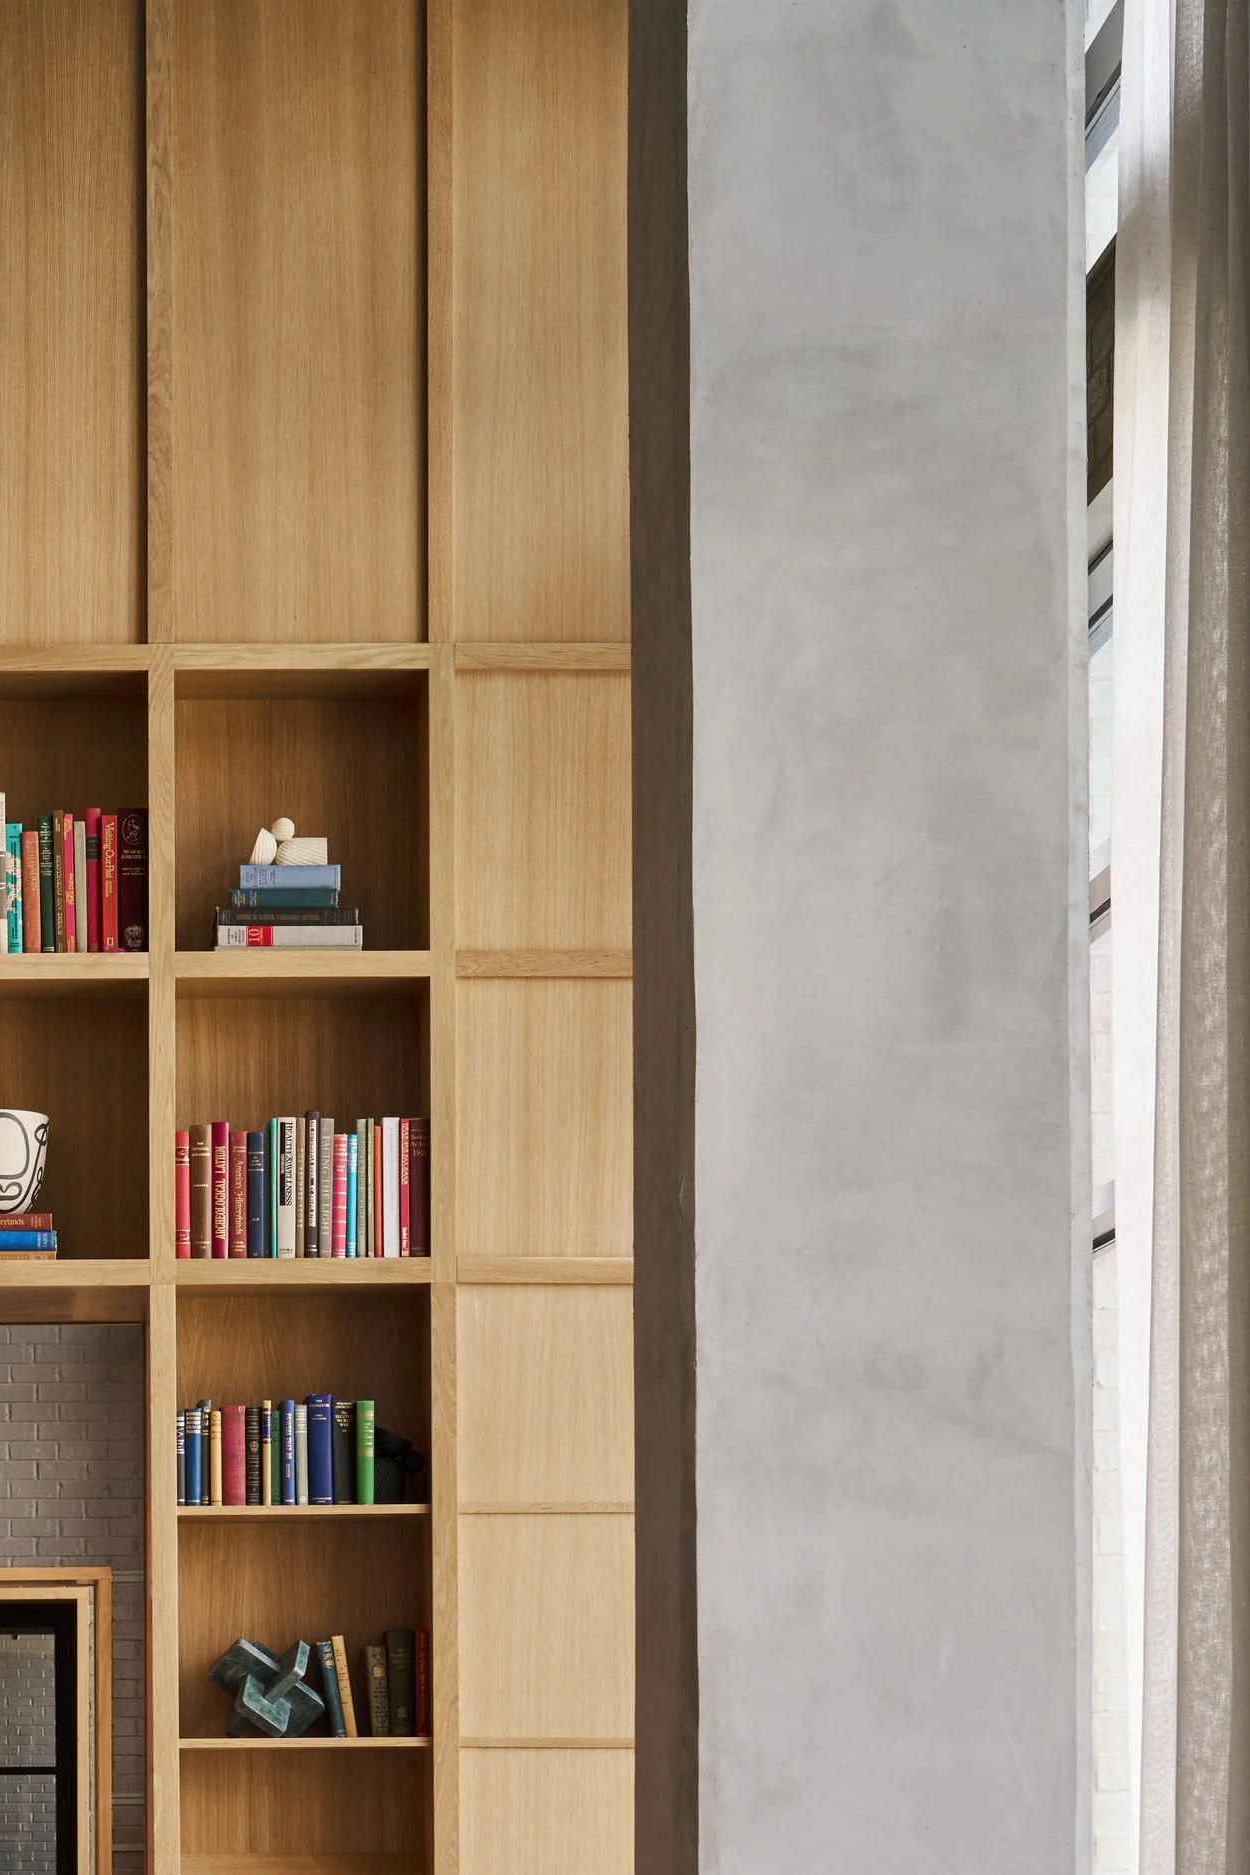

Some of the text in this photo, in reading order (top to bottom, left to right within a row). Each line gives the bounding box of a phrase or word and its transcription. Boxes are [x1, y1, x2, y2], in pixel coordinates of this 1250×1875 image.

[103, 822, 114, 880] Visiting Our Past
[248, 928, 260, 942] 10
[285, 1122, 293, 1155] HEALTH
[215, 1146, 225, 1240] ARCHEOLOGICAL LATIUM
[234, 1160, 243, 1235] America's Historylands
[285, 1164, 293, 1206] WELLNESS
[321, 1135, 330, 1238] FACING THE LIGHT
[286, 1452, 292, 1460] BE
